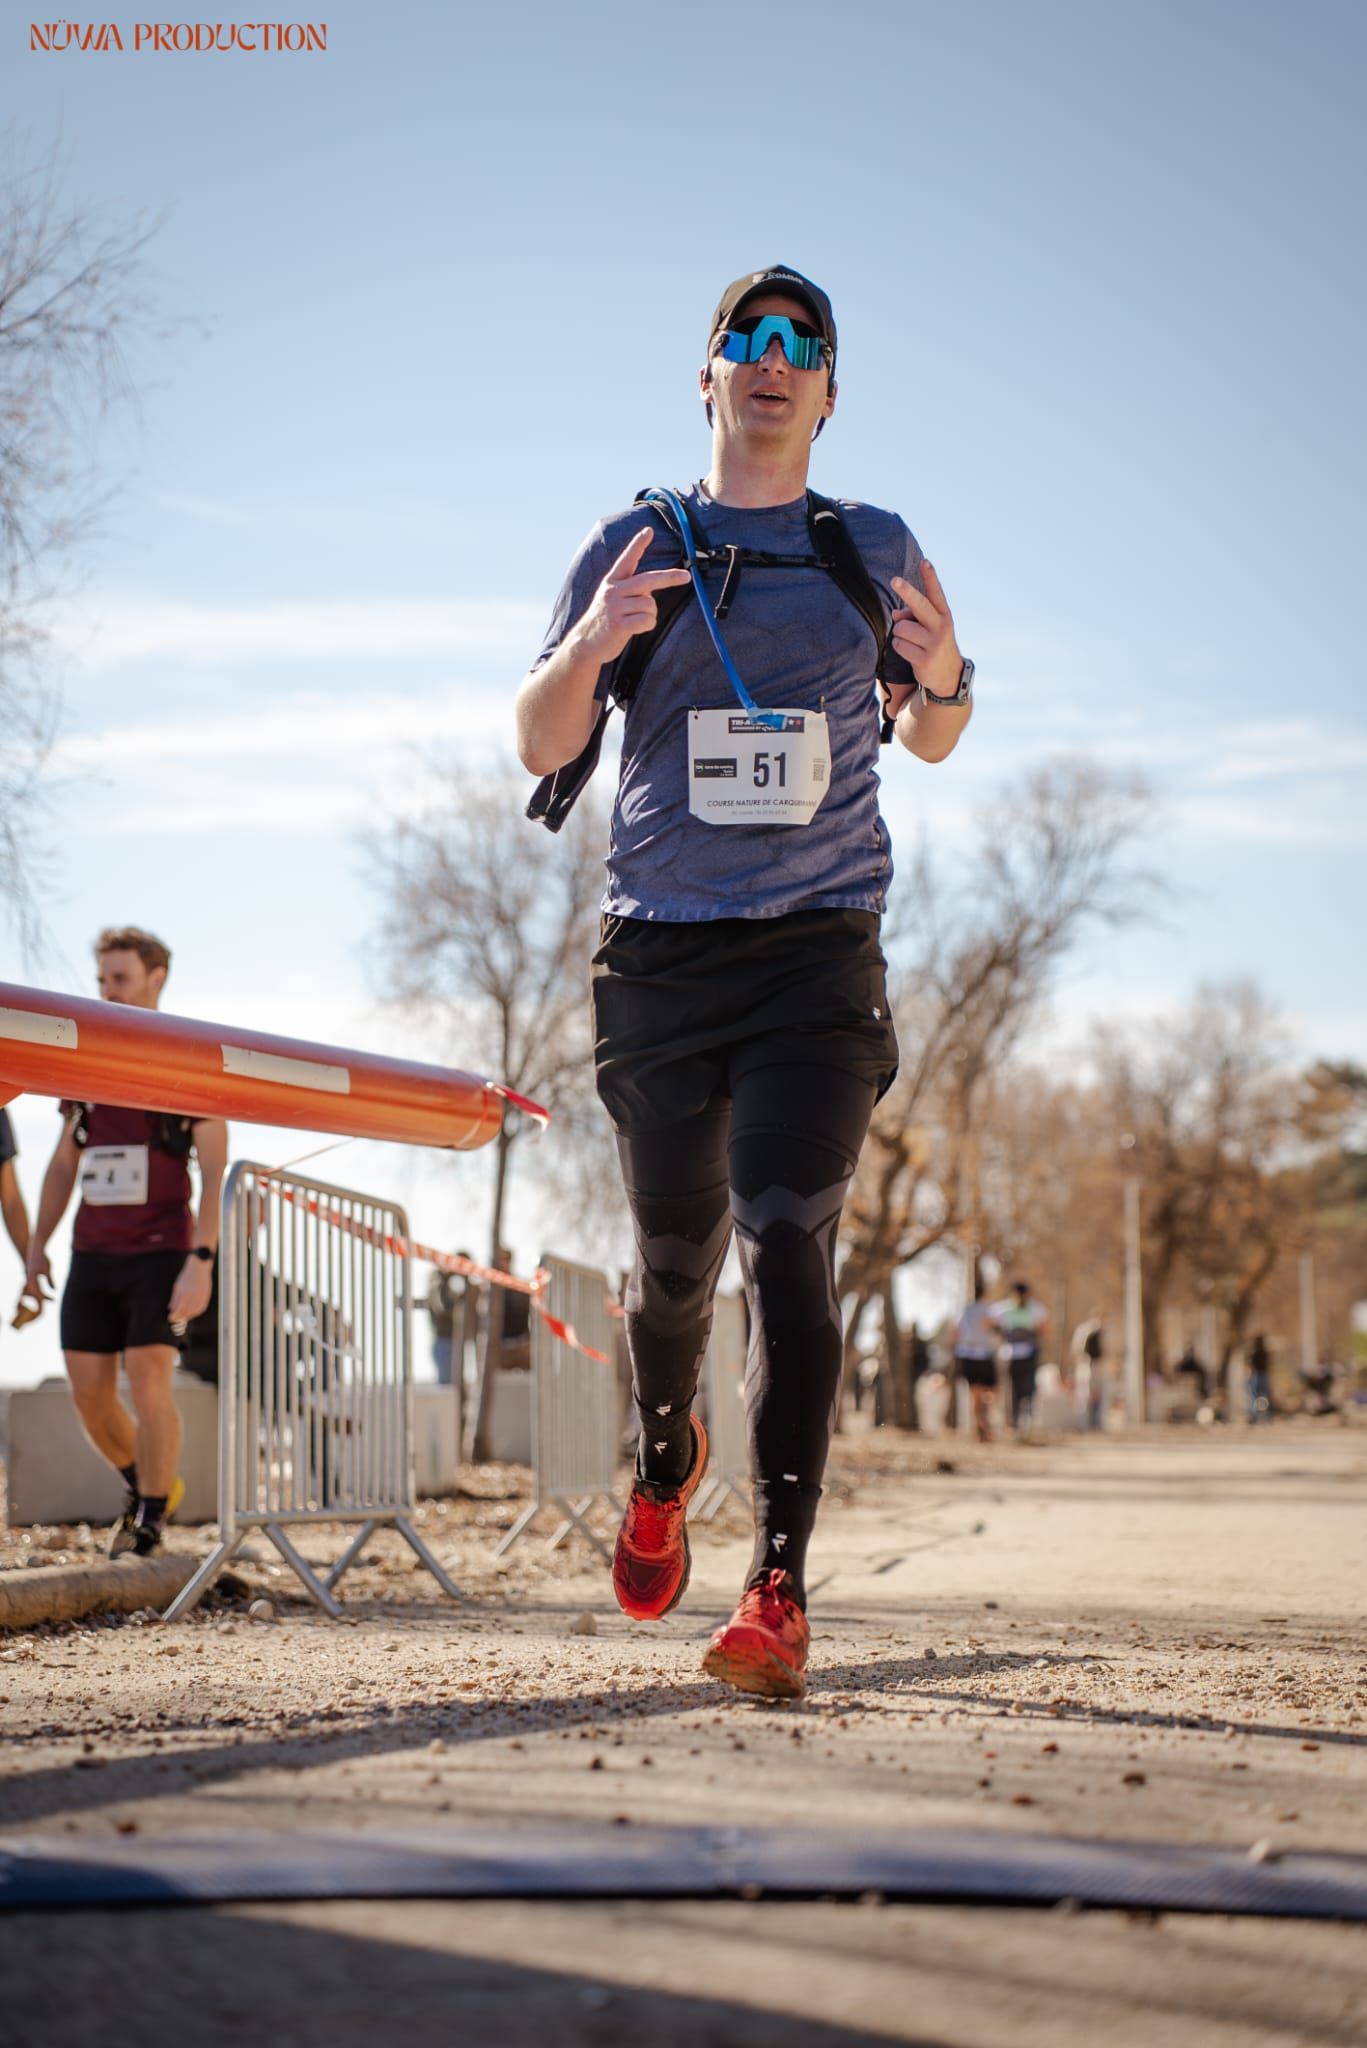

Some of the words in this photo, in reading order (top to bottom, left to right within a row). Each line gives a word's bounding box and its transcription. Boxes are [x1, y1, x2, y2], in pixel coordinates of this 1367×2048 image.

[753, 751, 786, 788] 51
[706, 799, 734, 808] COURSE
[735, 799, 761, 807] NATURE
[762, 799, 771, 807] DE
